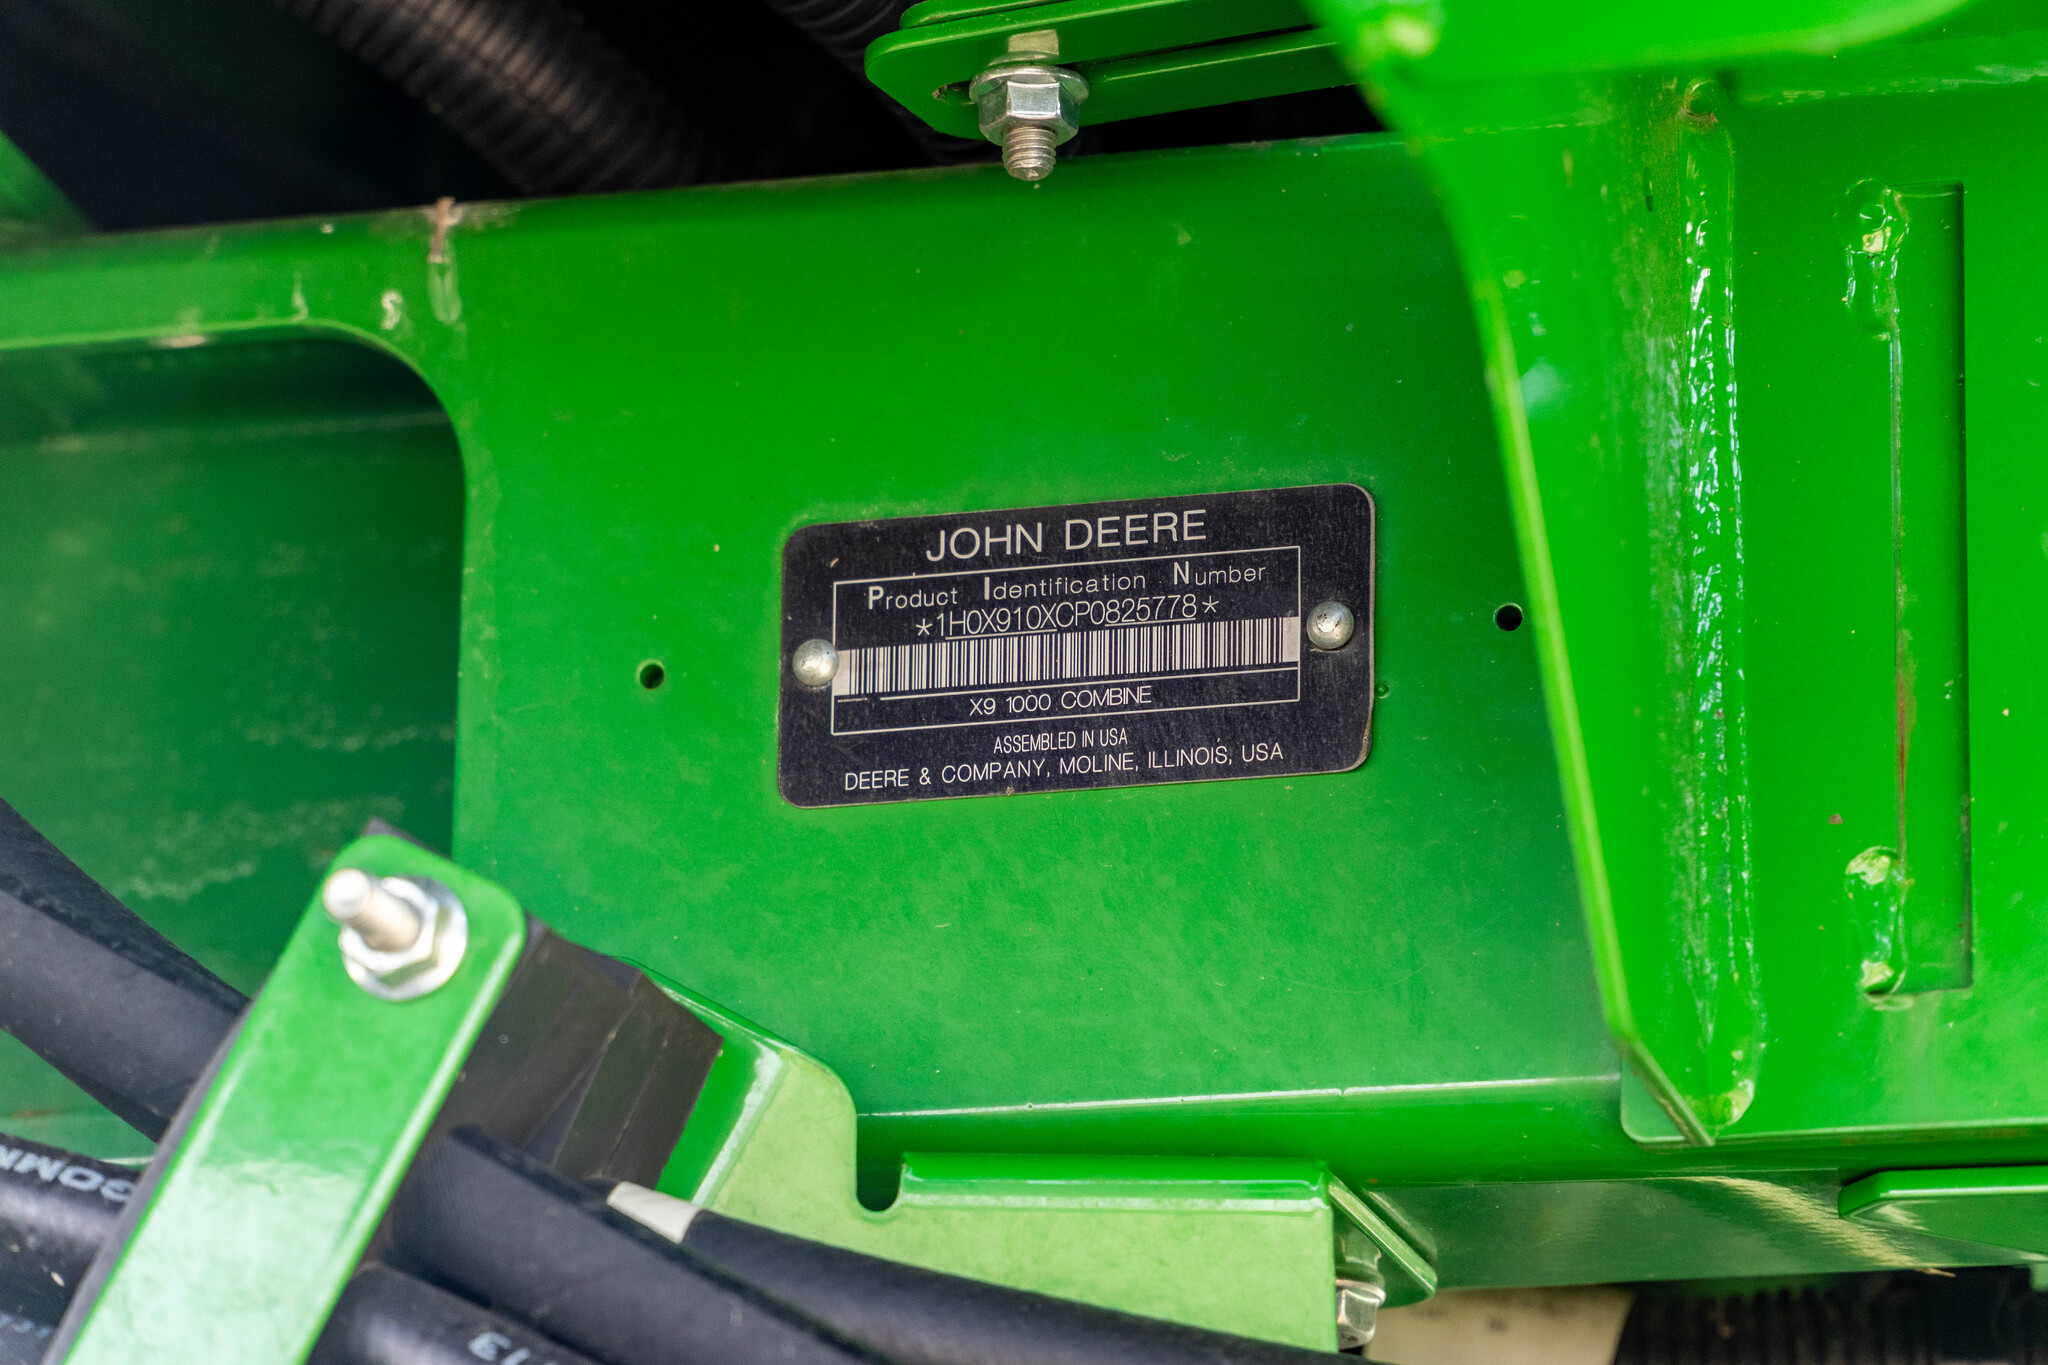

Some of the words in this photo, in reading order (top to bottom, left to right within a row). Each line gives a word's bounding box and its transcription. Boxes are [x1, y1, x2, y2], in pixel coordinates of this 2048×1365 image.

[926, 522, 1044, 562] JOHN
[1064, 510, 1207, 551] DEERE
[868, 585, 958, 610] Product
[983, 576, 1146, 600] Identification
[1173, 562, 1266, 585] Number
[970, 698, 997, 716] X9
[1006, 692, 1052, 714] 1000
[1061, 686, 1152, 709] COMBINE
[993, 732, 1077, 754] ASSEMBLED
[1081, 731, 1095, 748] IN
[1099, 728, 1127, 746] USA
[845, 768, 909, 792] DEERE
[919, 767, 931, 785] &
[941, 760, 1051, 784] COMPANY,
[1059, 752, 1139, 776] MOLINE,
[1147, 746, 1234, 769] ILLINOIS,
[1241, 743, 1283, 763] USA
